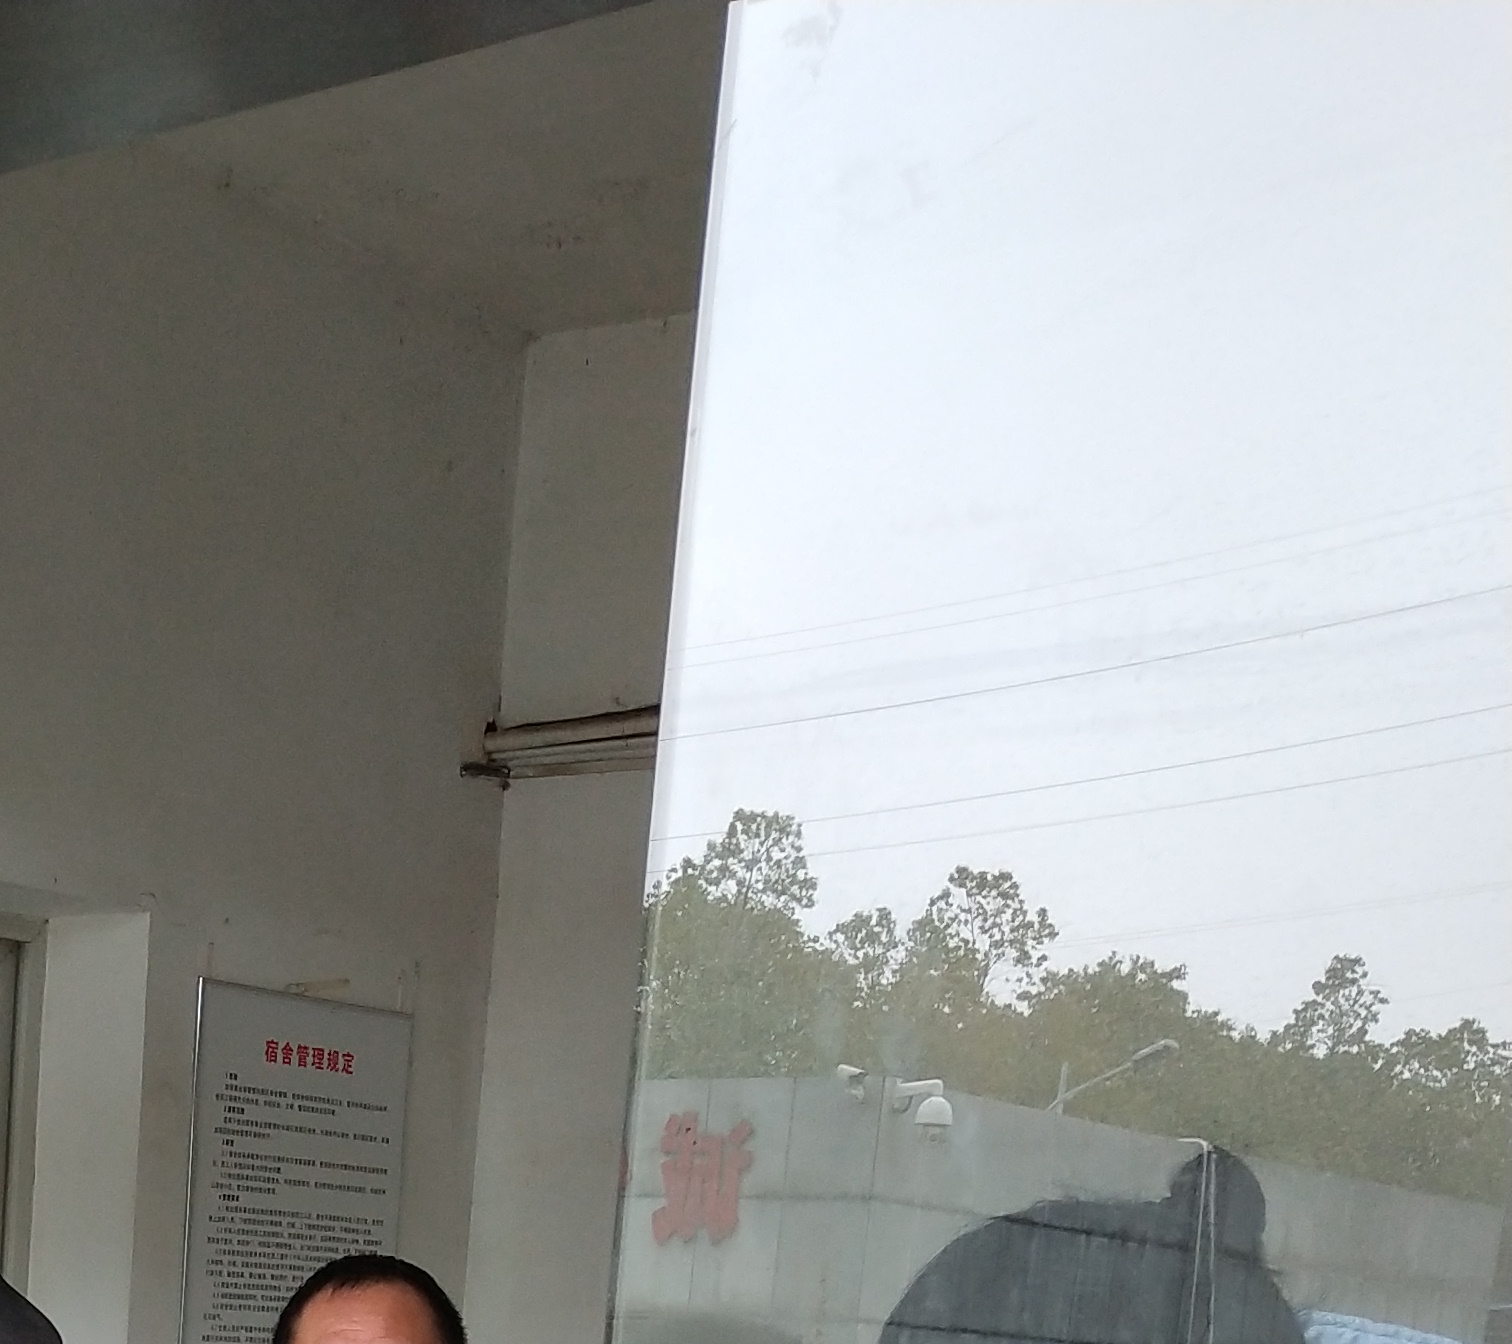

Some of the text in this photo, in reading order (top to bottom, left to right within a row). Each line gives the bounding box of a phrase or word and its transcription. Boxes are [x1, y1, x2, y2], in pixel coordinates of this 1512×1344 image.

[264, 1039, 355, 1074] 宿舍管理规定
